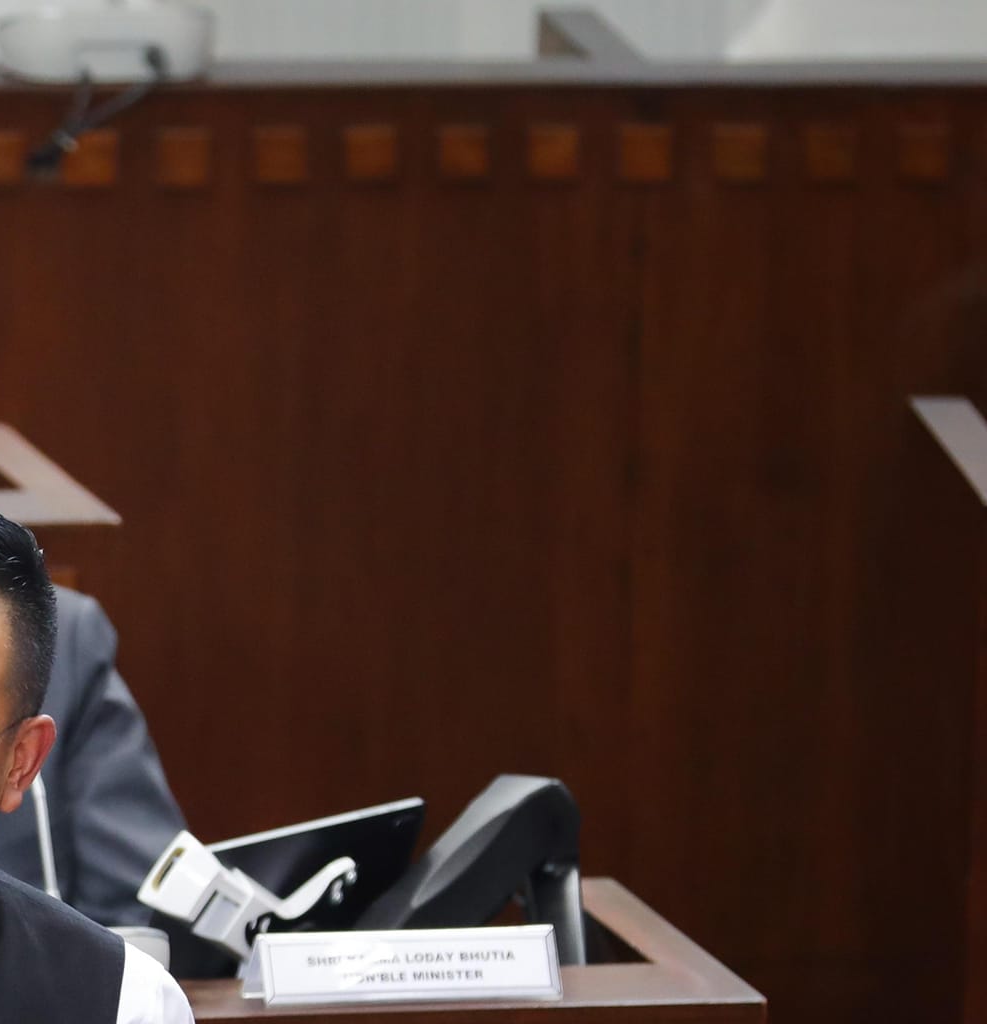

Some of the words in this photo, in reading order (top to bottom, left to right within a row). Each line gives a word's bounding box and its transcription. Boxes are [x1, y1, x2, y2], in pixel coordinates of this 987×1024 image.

[405, 952, 454, 964] LODAY
[459, 950, 516, 963] BHUTIA
[412, 969, 484, 982] MINISTER
